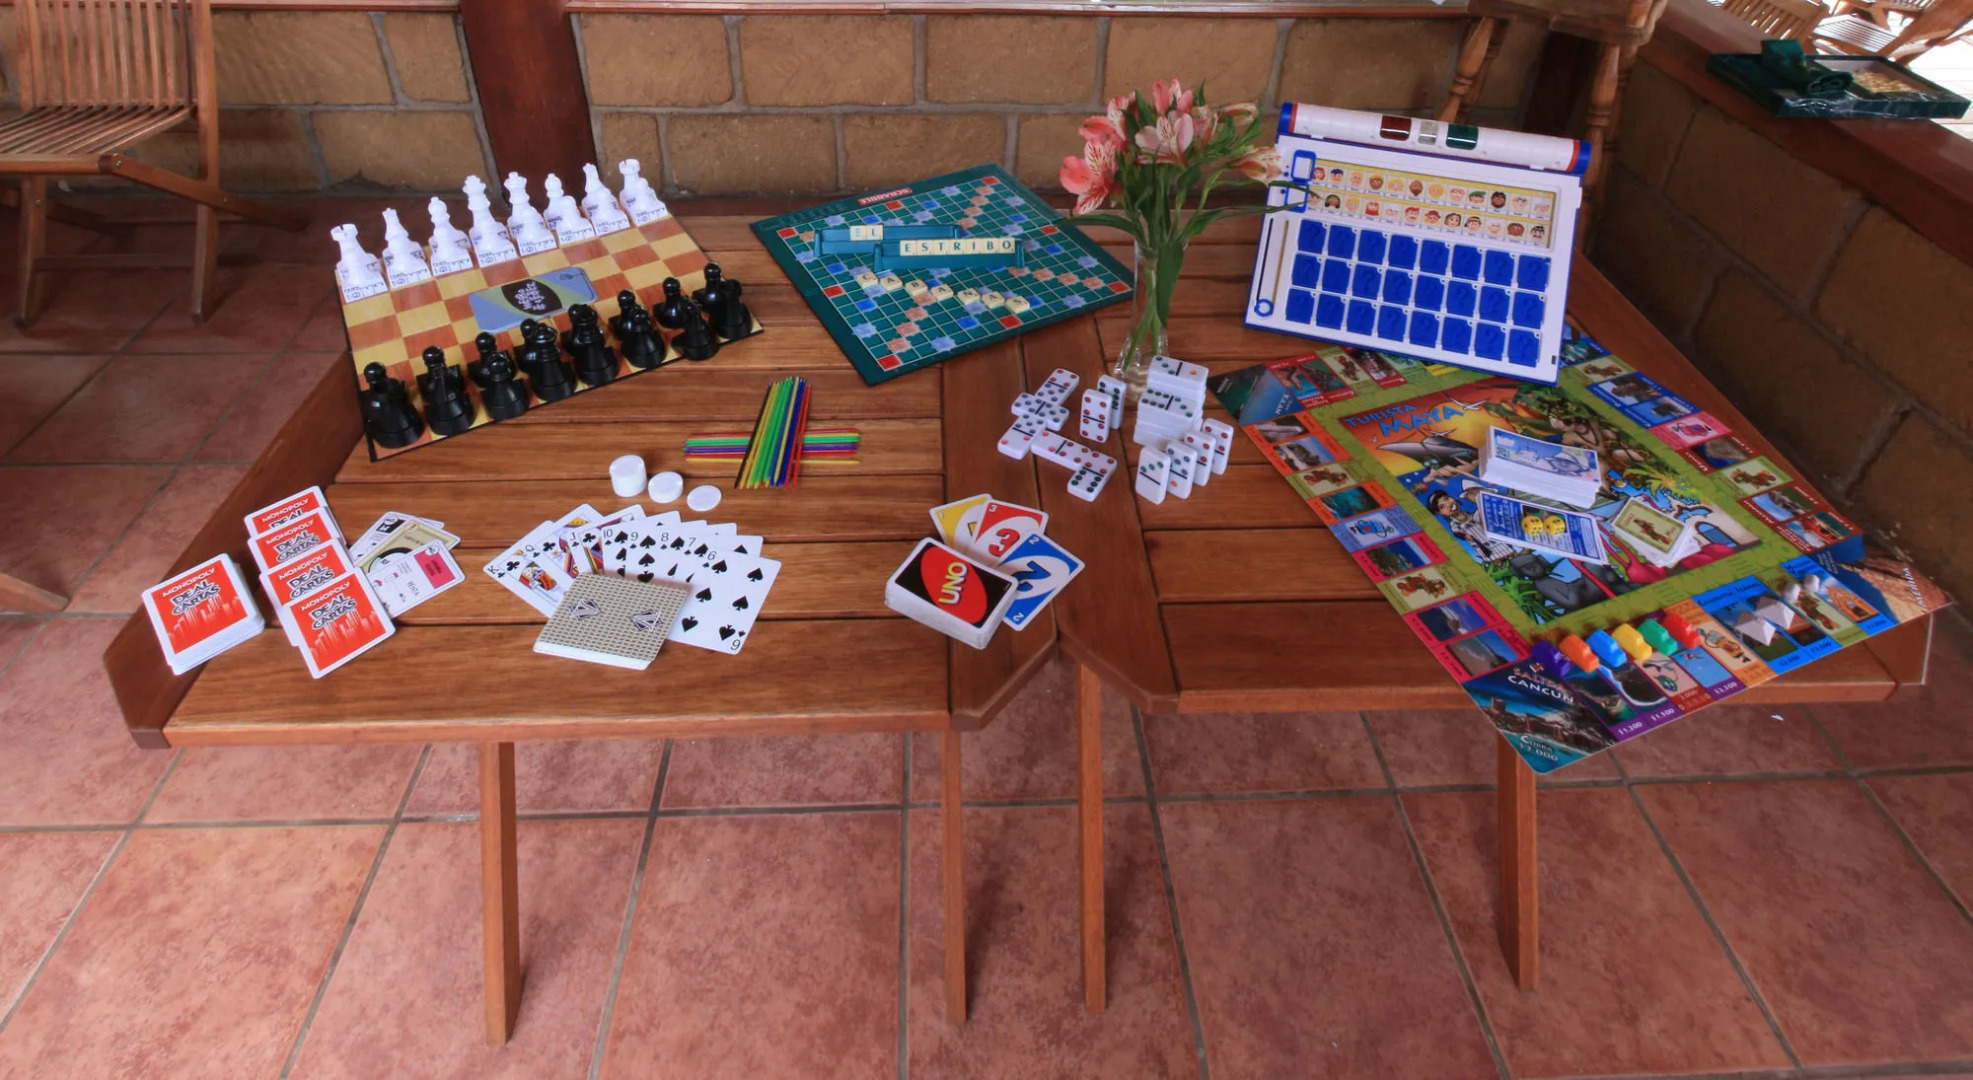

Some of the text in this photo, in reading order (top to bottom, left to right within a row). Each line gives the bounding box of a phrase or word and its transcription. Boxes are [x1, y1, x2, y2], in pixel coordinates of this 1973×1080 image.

[861, 188, 910, 205] SCRABBLE
[855, 227, 876, 237] EL
[905, 240, 1012, 253] ESTRIBO
[1343, 404, 1417, 427] TURISTA
[1379, 405, 1464, 437] MAYA
[262, 498, 309, 523] MONOPOLY
[989, 504, 998, 513] 3
[266, 519, 314, 545] MONOPOLY
[275, 531, 316, 554] DEAL
[570, 532, 577, 541] J
[602, 528, 613, 539] 10
[630, 531, 639, 542] 9
[660, 532, 669, 542] 8
[688, 537, 697, 547] 7
[988, 528, 1020, 557] 3
[1029, 536, 1040, 545] 2
[277, 536, 320, 562] CARTAS
[525, 544, 535, 553] Q
[707, 550, 717, 561] 6
[278, 552, 328, 580] MONOPOLY
[288, 564, 330, 590] DEAL
[489, 565, 499, 575] K
[1011, 560, 1051, 592] 2
[162, 567, 216, 598] MONOPOLY
[172, 579, 214, 605] DEAL
[291, 570, 334, 600] CARTAS
[938, 561, 969, 606] UNO
[172, 585, 220, 615] CARTAS
[301, 581, 351, 612] MONOPOLY
[311, 594, 352, 620] DEAL
[313, 600, 357, 629] CARTAS
[1012, 612, 1025, 623] 2
[730, 639, 741, 651] 6
[1507, 675, 1574, 704] CANCUN
[1513, 667, 1566, 690] SALIDA
